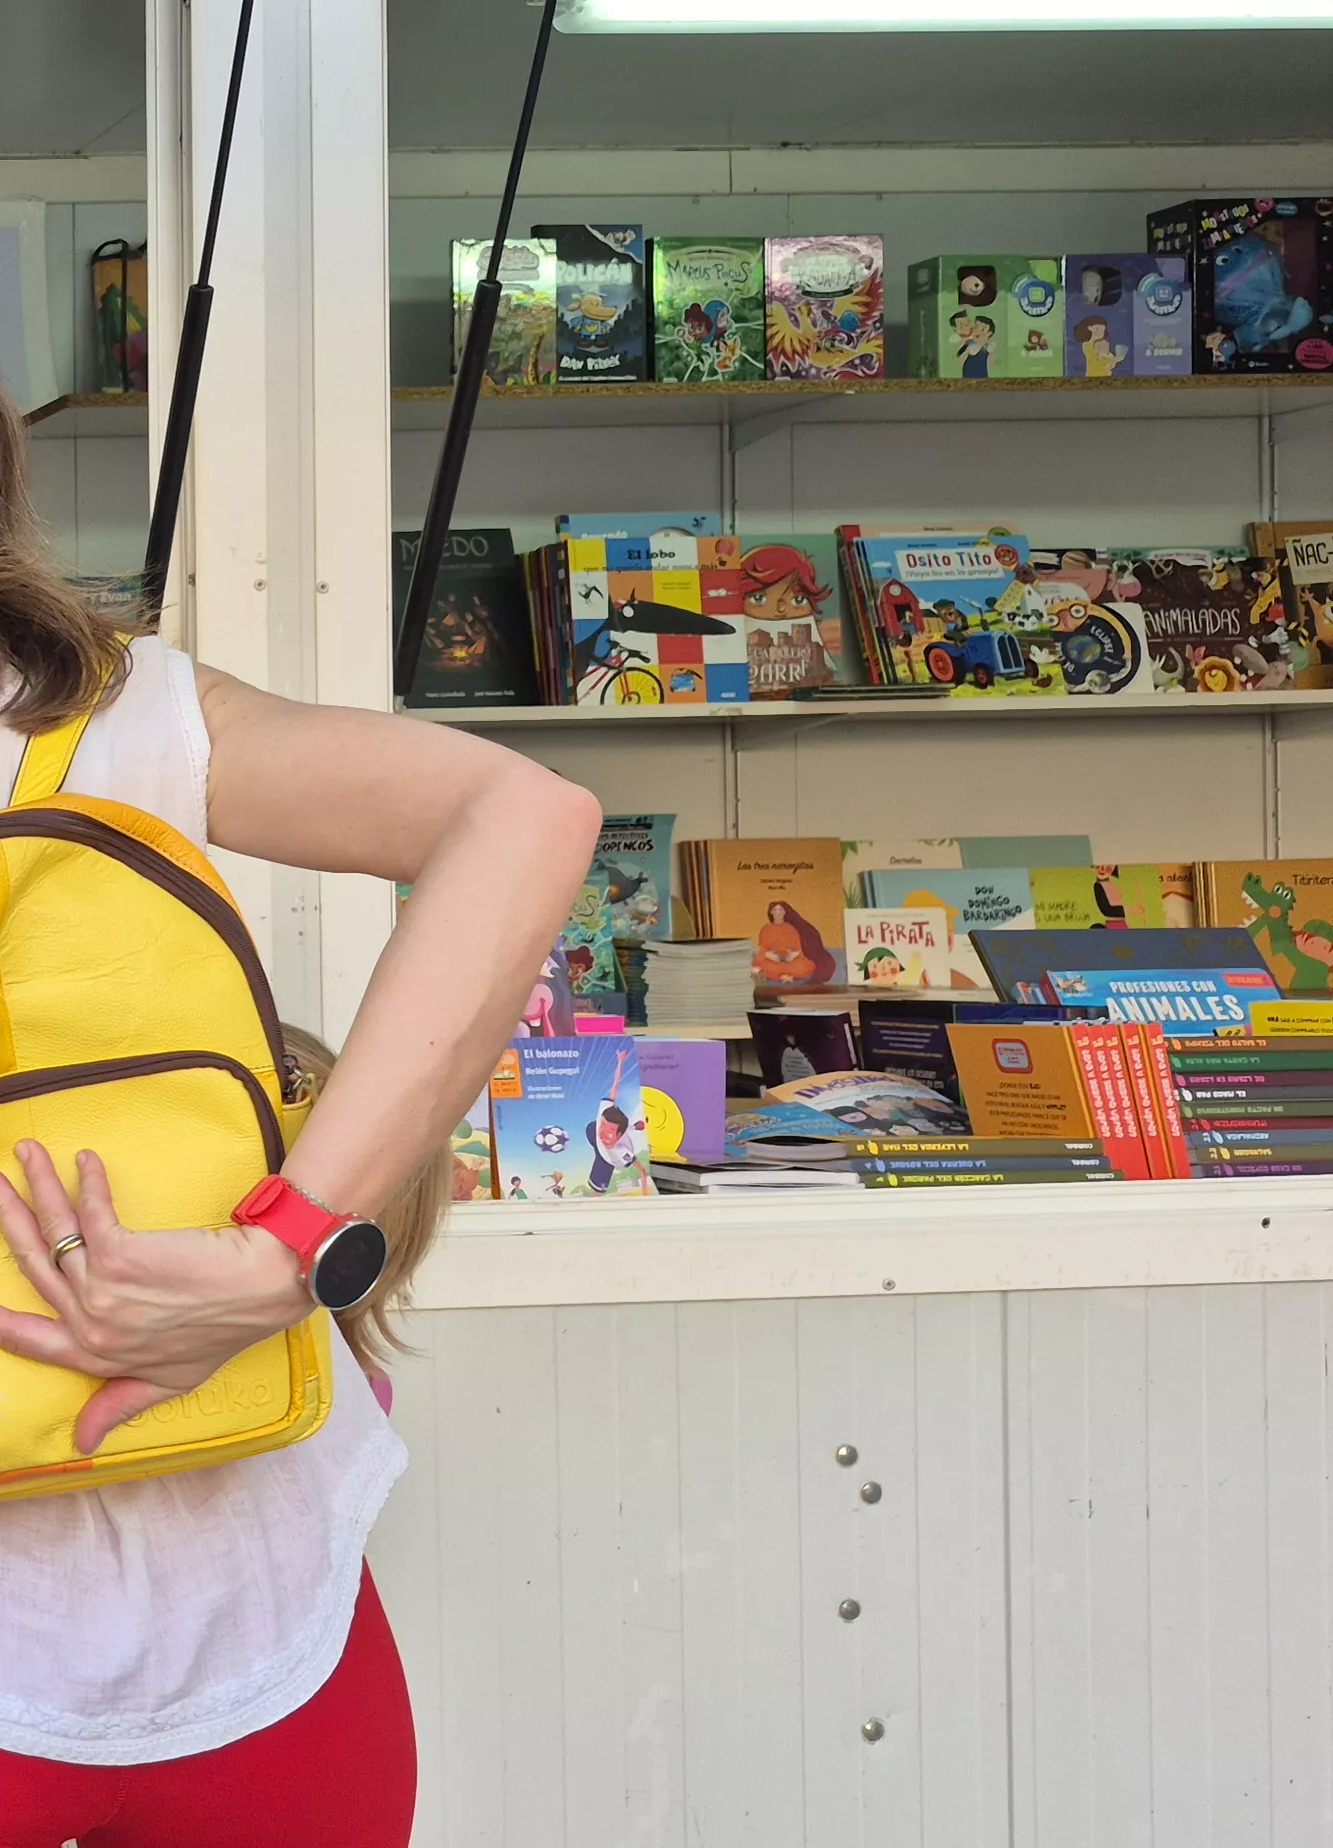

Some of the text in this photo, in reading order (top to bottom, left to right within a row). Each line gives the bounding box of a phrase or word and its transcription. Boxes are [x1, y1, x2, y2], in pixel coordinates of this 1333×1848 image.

[626, 548, 677, 561] El lobo
[906, 548, 993, 570] Osito Tito
[1143, 607, 1241, 639] ANIMALADAS
[974, 885, 994, 896] DON
[968, 896, 1010, 909] DOMINGO
[856, 921, 936, 948] LA PIRATA
[1107, 993, 1246, 1024] ANIMALES
[523, 1048, 580, 1059] El balonazo
